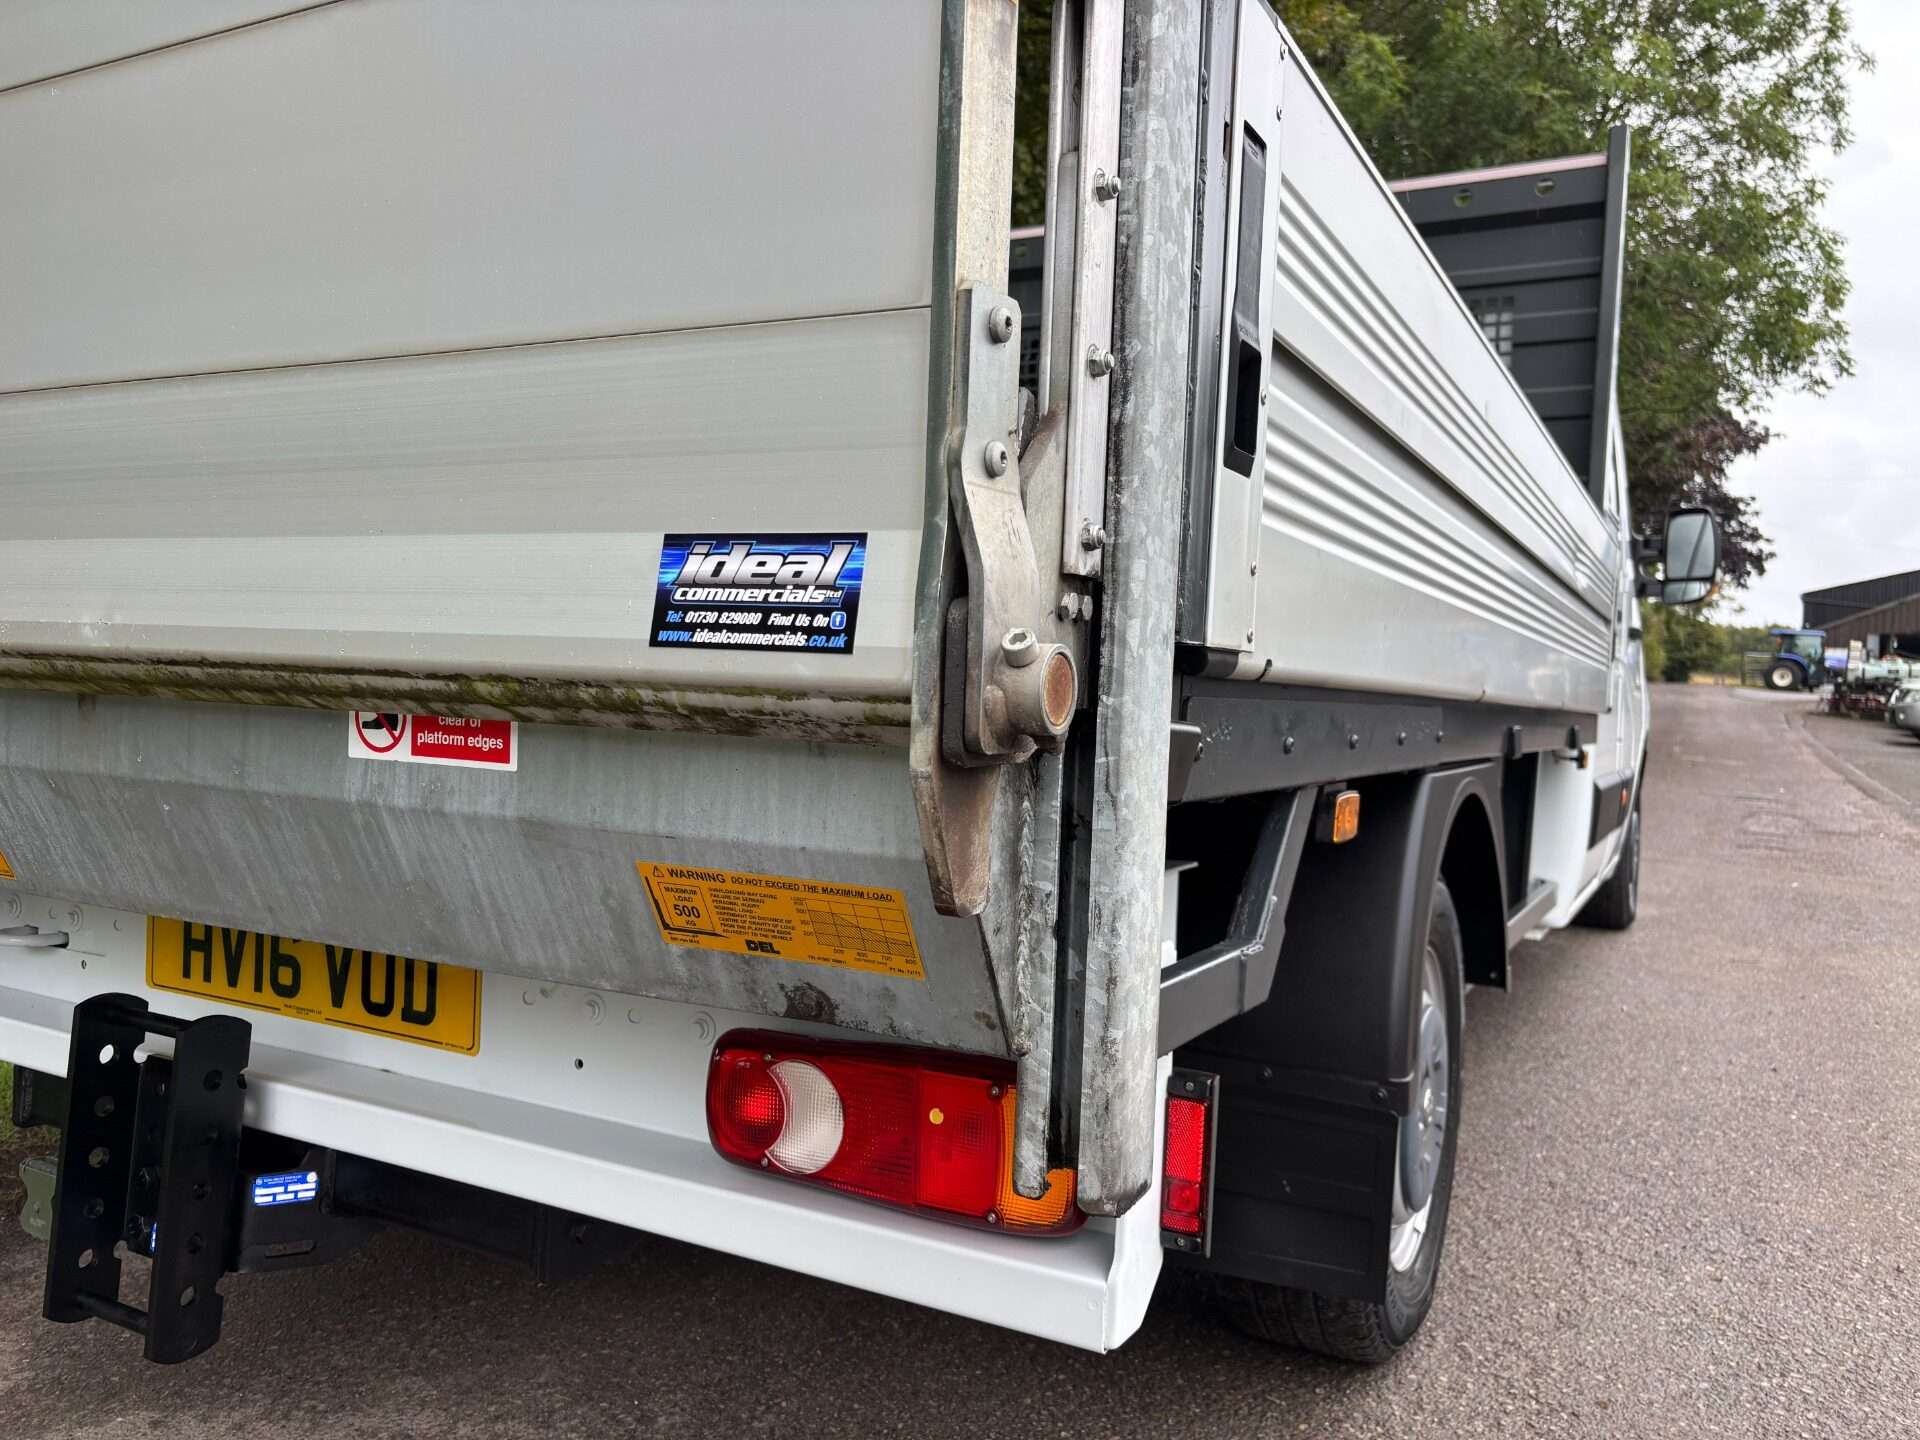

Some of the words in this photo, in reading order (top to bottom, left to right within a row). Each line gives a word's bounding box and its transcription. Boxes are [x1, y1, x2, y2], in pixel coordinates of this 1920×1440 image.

[672, 542, 857, 585] ideal
[673, 585, 826, 603] commercials
[665, 611, 684, 623] Tel:
[685, 612, 718, 624] 01730
[719, 612, 763, 625] 829080
[767, 613, 792, 626] Find
[795, 614, 811, 627] Us
[813, 614, 830, 627] On
[657, 629, 848, 649] www.idealcommercials.co.uk
[417, 730, 465, 746] platform
[467, 733, 504, 752] edges
[666, 867, 726, 884] WARNING
[731, 876, 745, 885] DO
[745, 877, 763, 887] NOT
[765, 879, 800, 892] EXCEED
[801, 884, 820, 894] THE
[821, 887, 865, 899] MAXIMUM
[673, 903, 701, 919] 500
[182, 920, 302, 999] HV16
